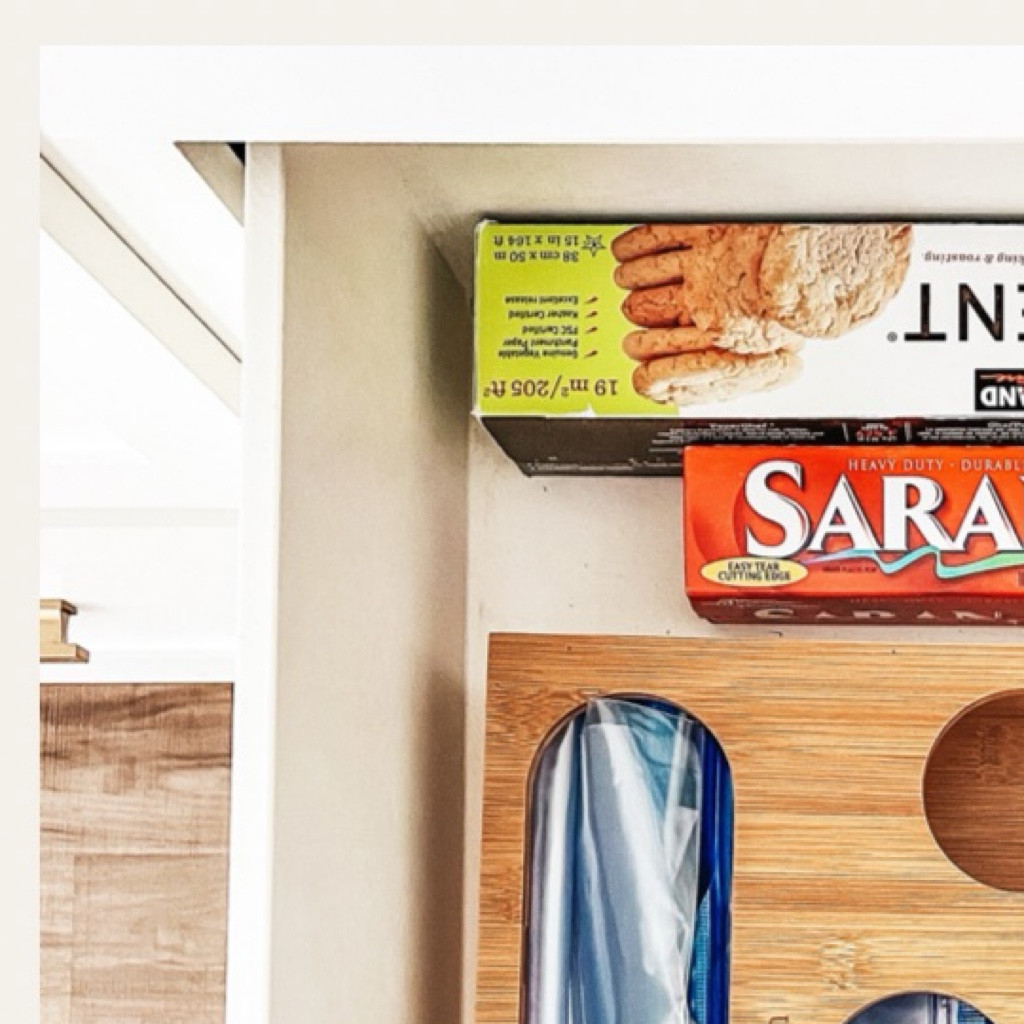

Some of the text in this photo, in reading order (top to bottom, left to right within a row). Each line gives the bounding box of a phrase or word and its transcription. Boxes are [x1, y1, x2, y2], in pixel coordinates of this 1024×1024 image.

[493, 235, 505, 246] ft
[548, 235, 561, 246] in
[565, 235, 579, 246] 15
[509, 251, 526, 262] 50
[563, 252, 579, 262] 38
[984, 252, 995, 263] &
[505, 295, 538, 304] release
[503, 338, 528, 349] Paper
[595, 379, 618, 396] 19
[848, 458, 896, 471] HEAVY
[903, 458, 944, 471] DUTY
[728, 561, 780, 570] EASY TEAR
[718, 571, 791, 581] CUTTING EDGE
